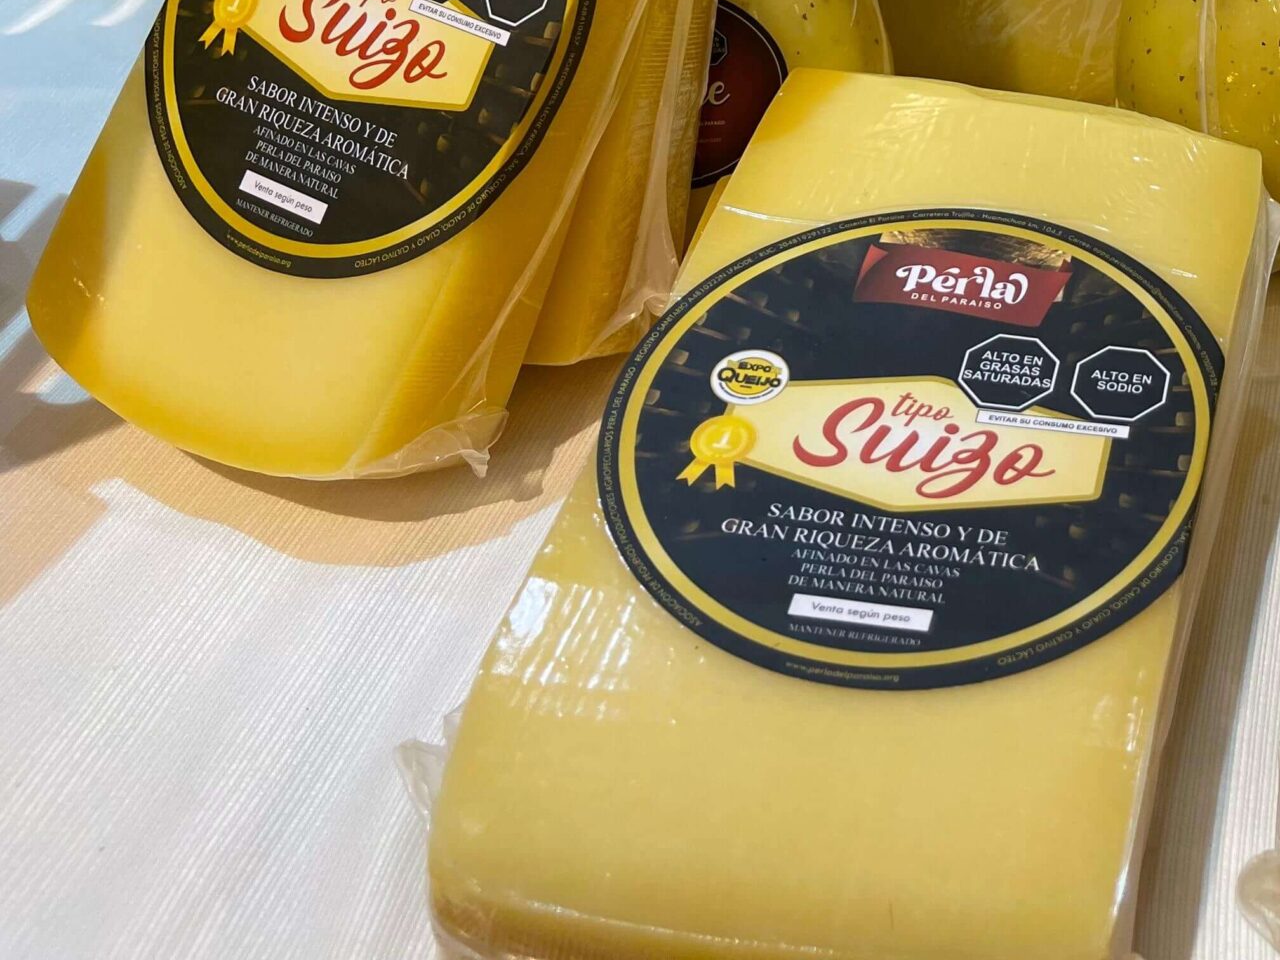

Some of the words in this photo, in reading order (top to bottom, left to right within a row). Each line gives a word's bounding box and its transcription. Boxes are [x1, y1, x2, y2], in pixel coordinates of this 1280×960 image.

[419, 4, 439, 15] EVITAR
[447, 13, 474, 29] CONSUMO
[474, 23, 502, 39] EXCESIVO
[247, 76, 297, 107] SABOR
[299, 96, 362, 133] INTENSO
[363, 122, 376, 138] Y
[374, 127, 398, 148] DE
[216, 87, 259, 115] GRAN
[258, 104, 320, 142] RIQUEZA
[321, 132, 410, 180] AROMÁTICA
[254, 126, 295, 148] AFINADO
[295, 142, 308, 154] EN
[308, 148, 327, 162] LAS
[327, 156, 356, 174] CAVAS
[256, 141, 284, 160] PERLA
[284, 152, 301, 167] DEL
[303, 161, 342, 184] PARAISO
[254, 181, 274, 196] Venta
[274, 191, 295, 205] según
[295, 201, 313, 212] peso
[911, 292, 937, 302] DEL
[941, 296, 1002, 309] PARAISO
[738, 361, 772, 372] EXPO
[980, 361, 1040, 376] GRASAS
[982, 351, 1019, 363] ALTO
[1023, 355, 1044, 366] EN
[717, 367, 781, 388] QUEIJO
[963, 370, 1051, 388] SATURADAS
[1091, 370, 1129, 381] ALTO
[1132, 374, 1152, 384] EN
[1097, 381, 1143, 394] SODIO
[891, 392, 954, 427] tipo
[989, 414, 1018, 424] EVITAR
[1033, 419, 1075, 430] CONSUMO
[1077, 424, 1118, 434] EXCESIVO
[793, 397, 1055, 498] Suizo
[768, 503, 845, 526] SABOR
[851, 513, 951, 539] INTENSO
[956, 526, 974, 541] Y
[977, 529, 1009, 545] DE
[721, 518, 789, 540] GRAN
[793, 528, 894, 555] RIQUEZA
[899, 545, 1041, 572] AROMÁTICA
[791, 548, 858, 565] AFINADO
[861, 556, 880, 569] EN
[883, 559, 912, 572] LAS
[913, 563, 960, 578] CAVAS
[801, 563, 847, 578] PERLA
[850, 568, 878, 582] DEL
[881, 574, 943, 589] PARAISO
[788, 575, 809, 587] DE
[813, 577, 874, 595] MANERA
[878, 587, 946, 604] NATURAL
[811, 601, 844, 615] Venta
[847, 607, 881, 621] según
[883, 612, 911, 623] peso
